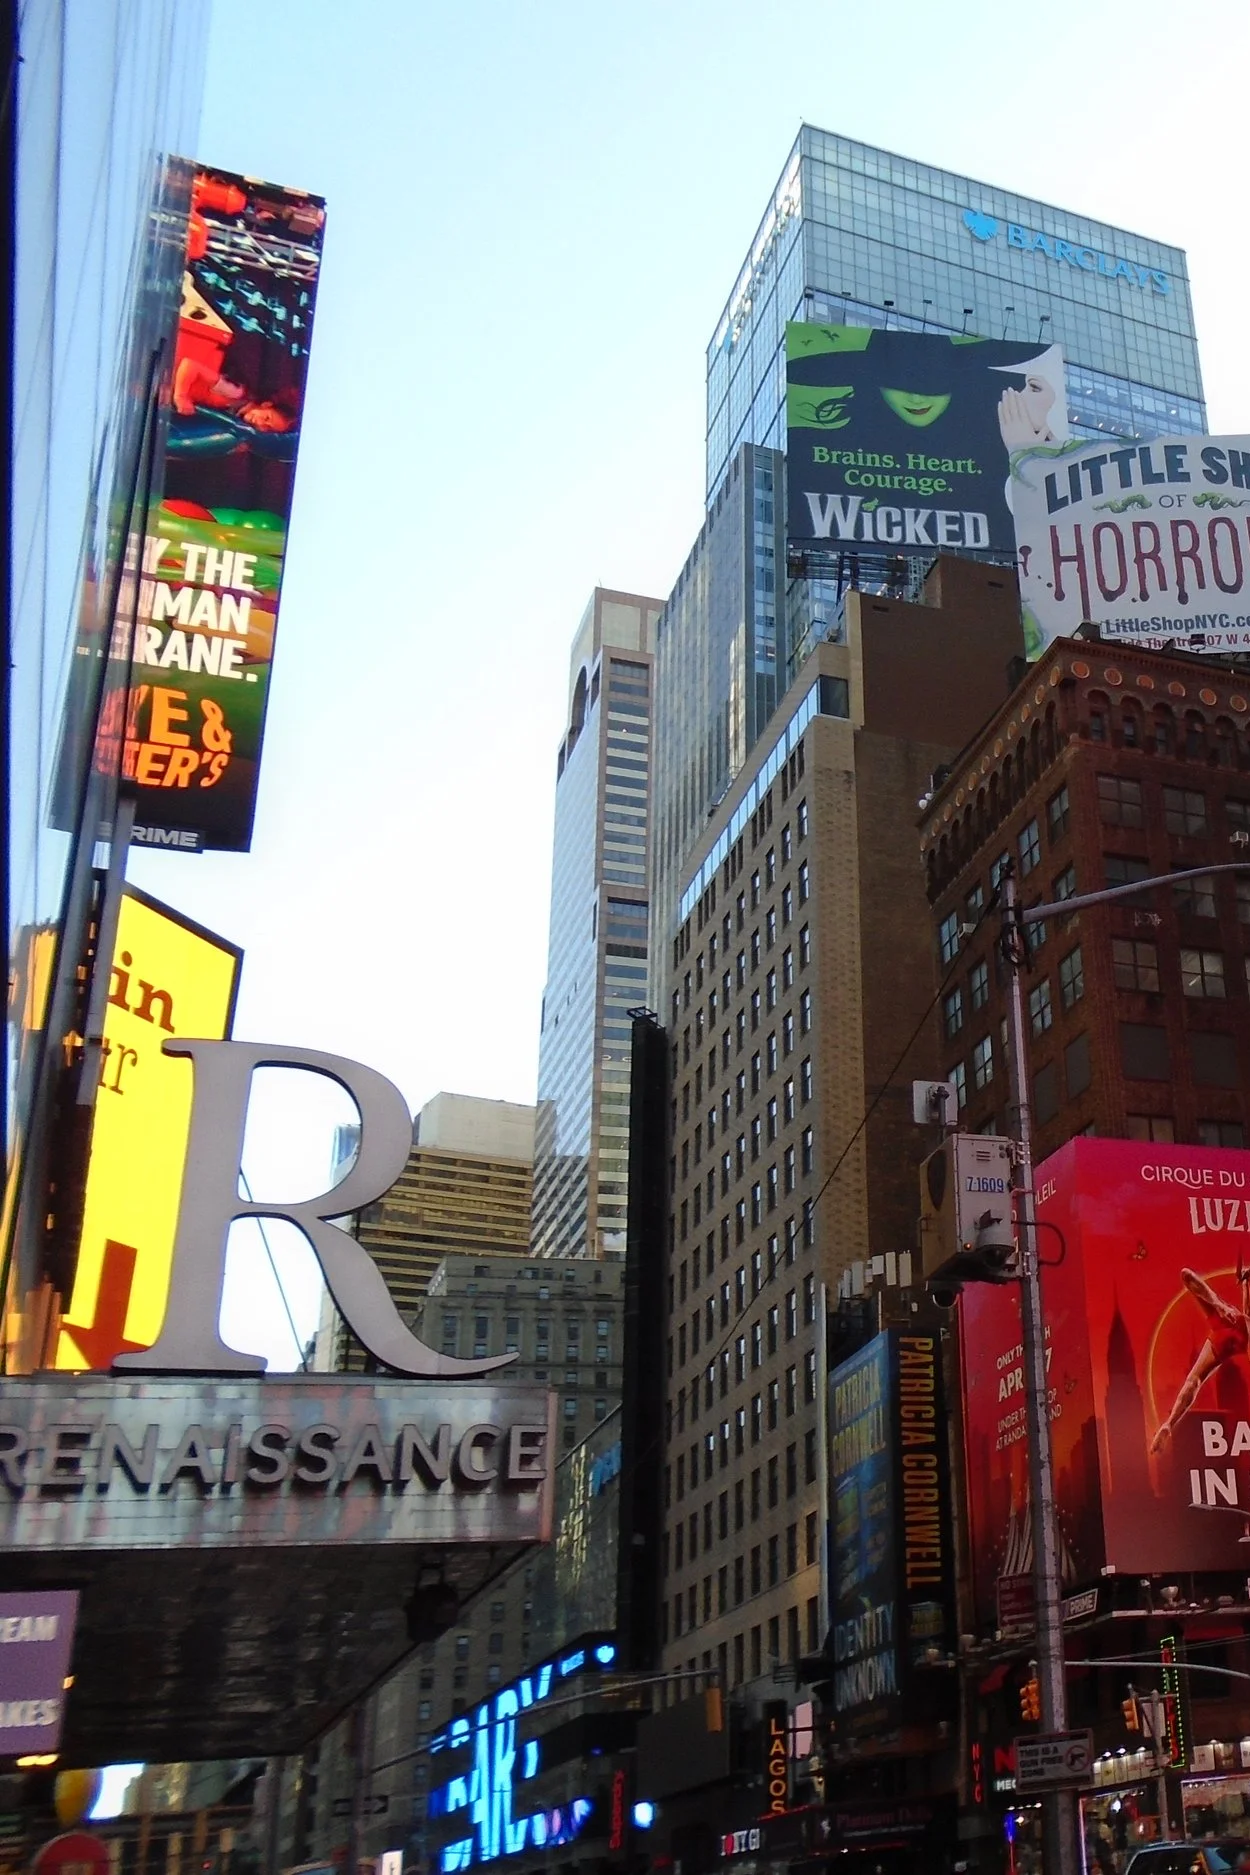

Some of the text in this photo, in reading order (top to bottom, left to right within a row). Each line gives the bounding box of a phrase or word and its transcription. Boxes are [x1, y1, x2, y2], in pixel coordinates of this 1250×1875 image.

[1007, 223, 1171, 295] BARCLAYS
[813, 446, 983, 475] Brains. Heart.
[844, 469, 954, 496] Courage.
[1045, 445, 1192, 514] LITTLE
[804, 491, 991, 549] WICKED
[1159, 494, 1188, 509] OF
[181, 543, 258, 591] THE
[152, 582, 251, 635] MAN
[140, 626, 258, 682] RANE.
[1205, 634, 1222, 646] 07
[1226, 634, 1240, 645] W
[201, 699, 232, 753] &
[131, 825, 200, 848] RIME
[1141, 1165, 1214, 1190] CIRQUE
[1220, 1170, 1245, 1187] DU
[111, 1038, 519, 1377] R
[997, 1350, 1017, 1370] ONLY
[998, 1368, 1024, 1402] APR
[900, 1336, 937, 1446] PATRICIA
[0, 1424, 549, 1485] RENAISSANCE
[1189, 1468, 1239, 1506] IN
[902, 1453, 943, 1590] CORNWELL
[768, 1717, 788, 1815] LAGOS
